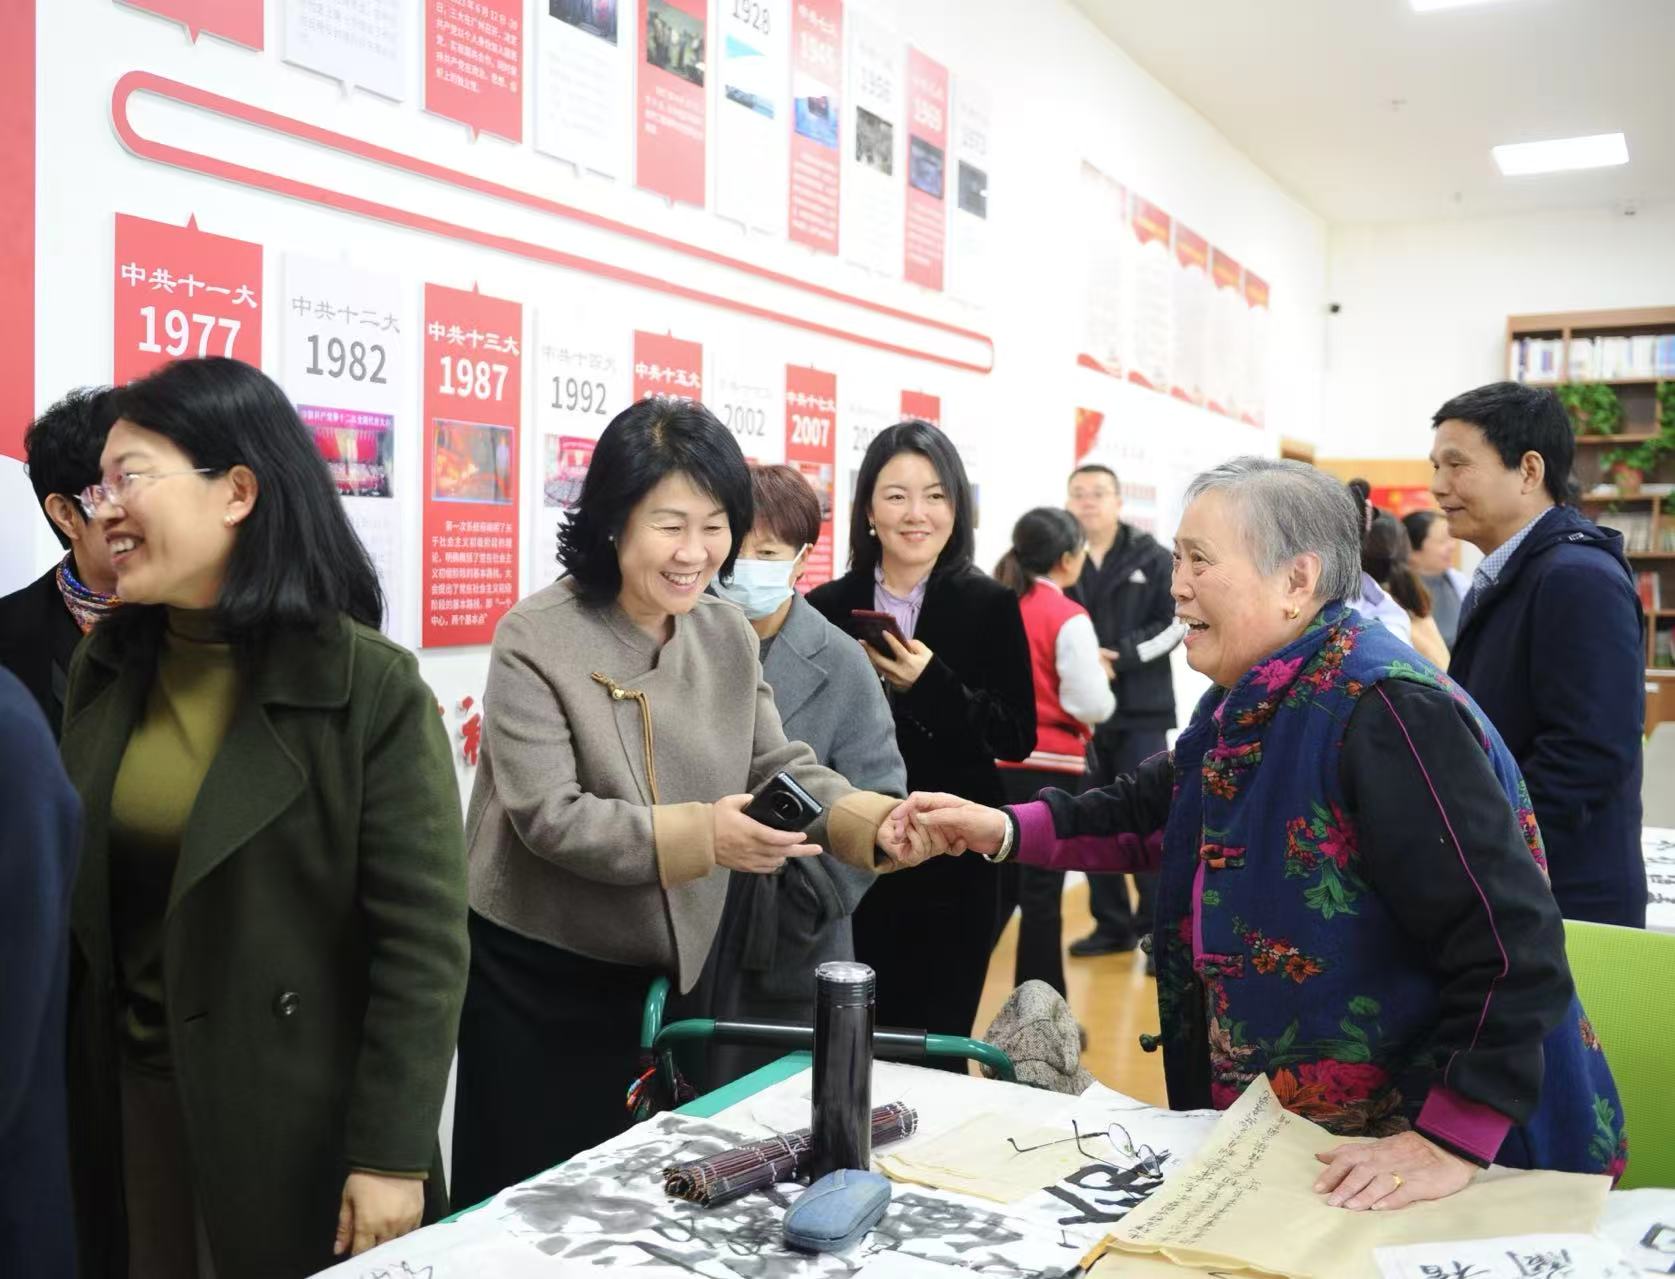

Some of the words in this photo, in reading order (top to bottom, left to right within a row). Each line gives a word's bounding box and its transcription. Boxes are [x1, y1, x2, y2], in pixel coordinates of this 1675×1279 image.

[121, 262, 258, 308] 中共十一大
[138, 305, 241, 360] 1977
[292, 296, 400, 333] 中共十二大
[428, 321, 520, 356] 中共十三大
[306, 334, 387, 384] 1982
[635, 361, 701, 389] 中共十五大
[439, 355, 509, 401] 1987
[551, 376, 607, 414] 1992
[724, 404, 766, 436] 2002
[791, 414, 831, 448] 2007
